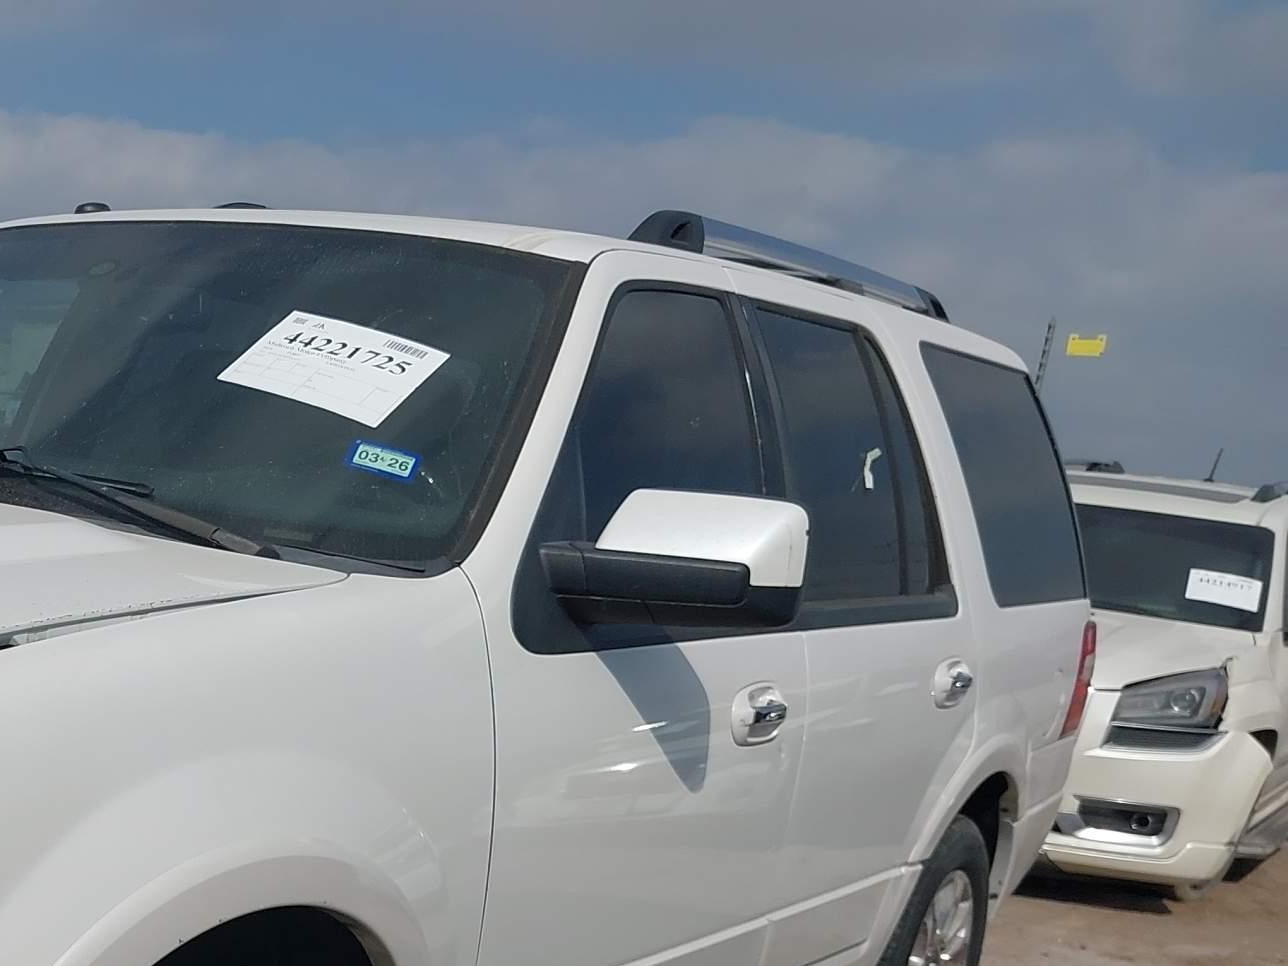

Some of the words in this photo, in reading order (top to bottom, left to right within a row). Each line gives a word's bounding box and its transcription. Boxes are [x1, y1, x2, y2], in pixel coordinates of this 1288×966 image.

[283, 331, 415, 377] 44221725
[358, 450, 380, 463] 03
[387, 457, 410, 472] 26
